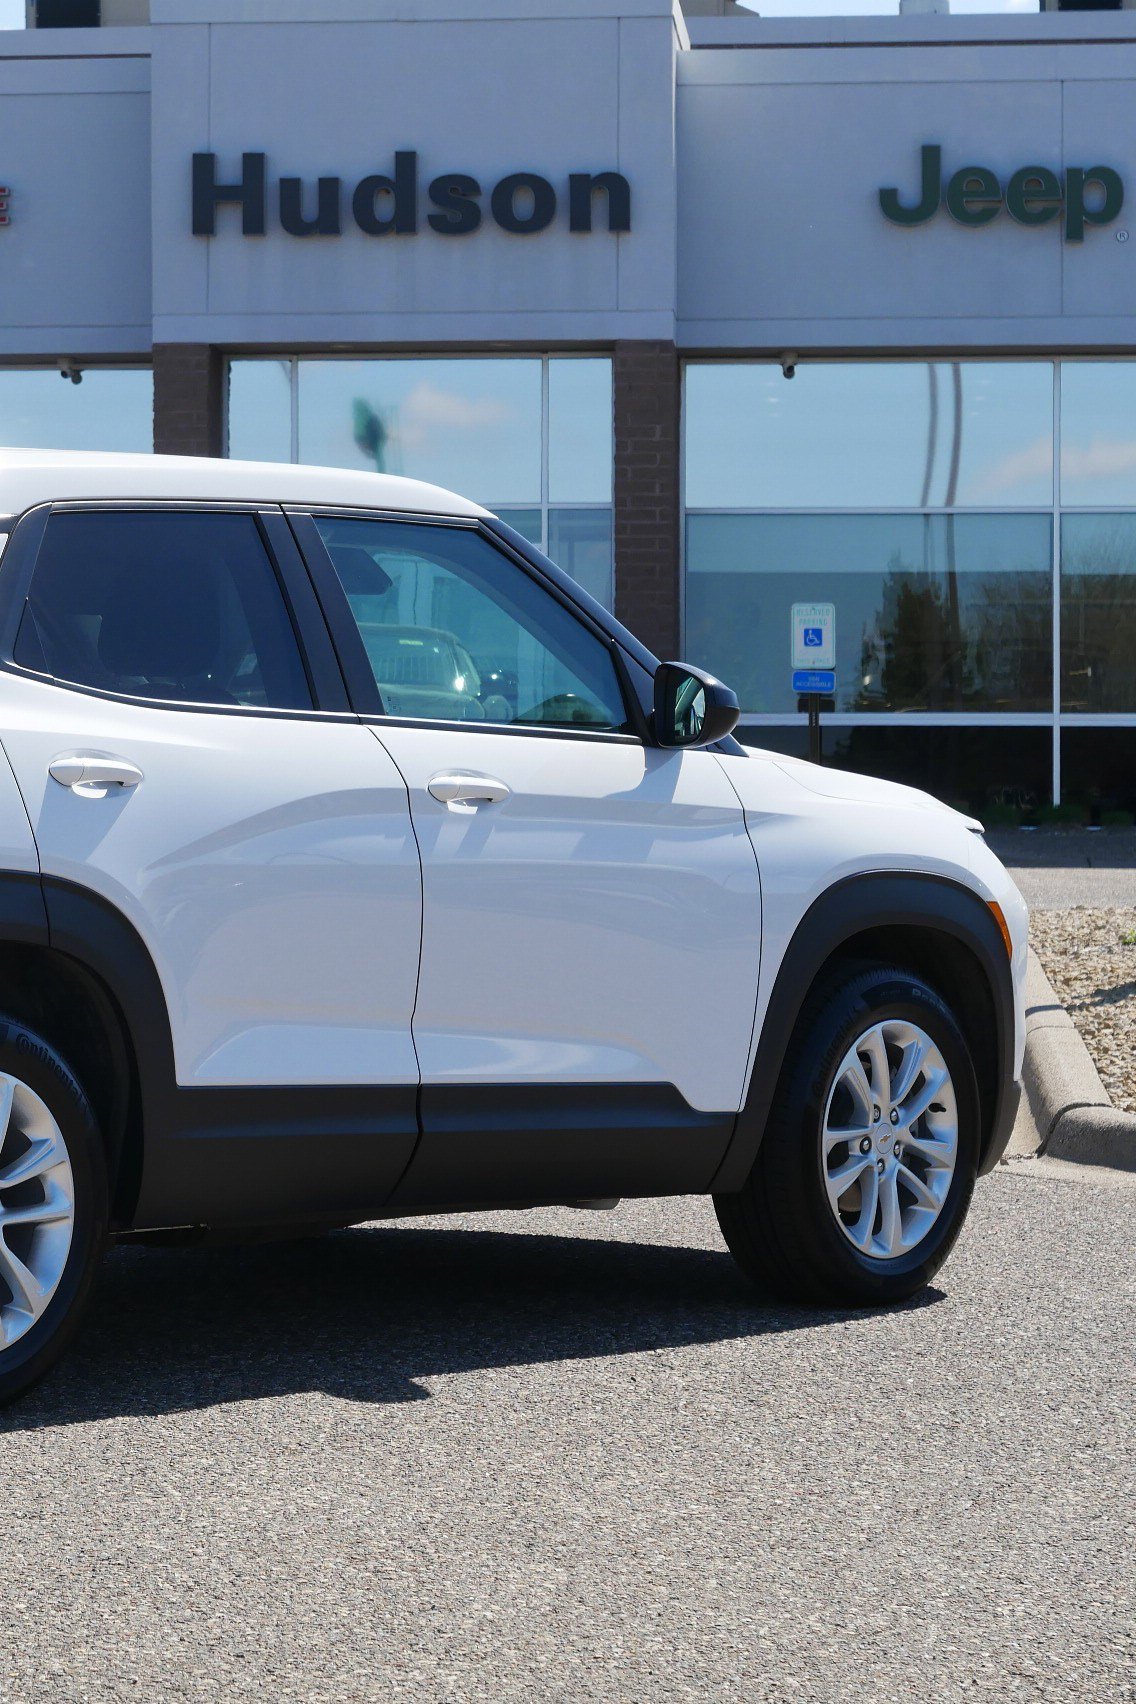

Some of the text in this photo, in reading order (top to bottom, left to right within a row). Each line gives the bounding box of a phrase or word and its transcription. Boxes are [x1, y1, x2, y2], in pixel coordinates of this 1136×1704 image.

[192, 150, 631, 236] Hudson
[878, 144, 1124, 242] Jeep
[796, 608, 830, 617] RESERVED
[798, 618, 828, 626] PARKING
